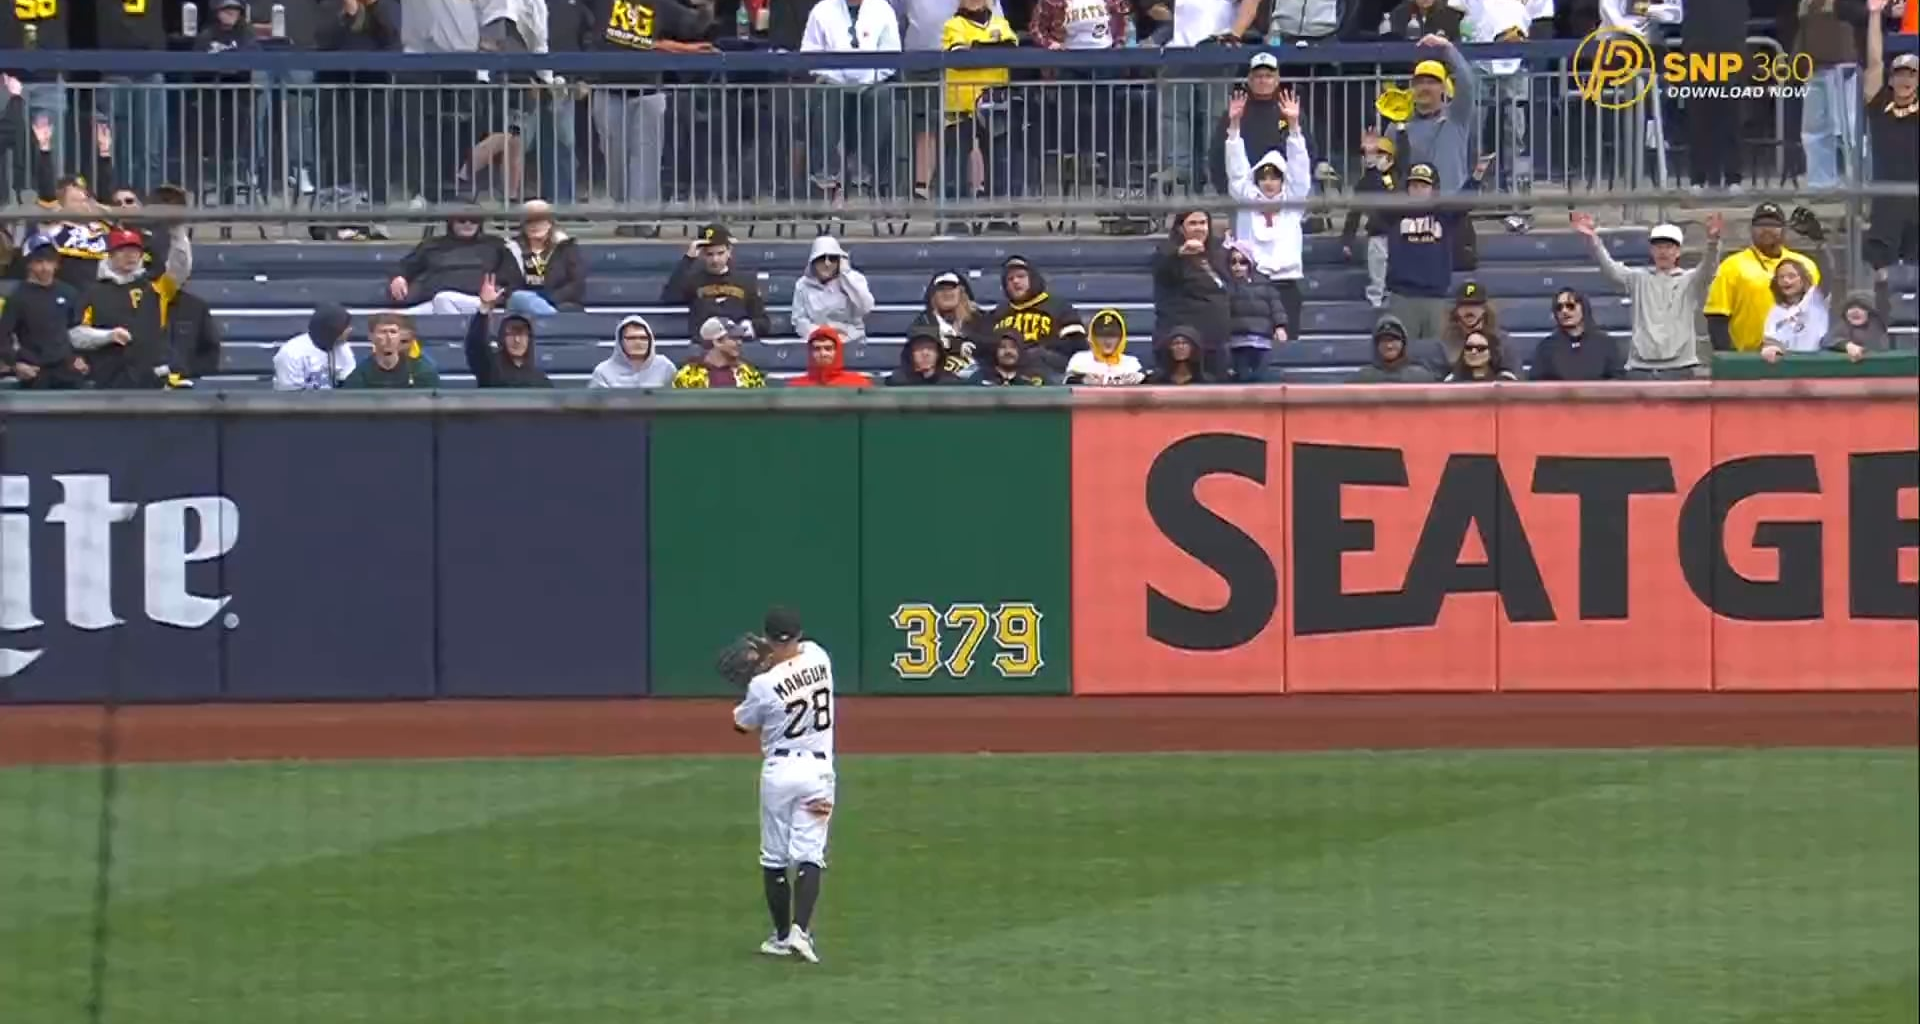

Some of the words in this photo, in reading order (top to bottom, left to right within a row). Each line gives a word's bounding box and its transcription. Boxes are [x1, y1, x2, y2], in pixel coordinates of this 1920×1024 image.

[129, 287, 143, 309] P
[1466, 285, 1475, 296] P
[1145, 431, 1919, 652] SEATGE
[890, 604, 1044, 679] 379
[773, 664, 828, 701] MANGUM
[783, 687, 831, 739] 28
